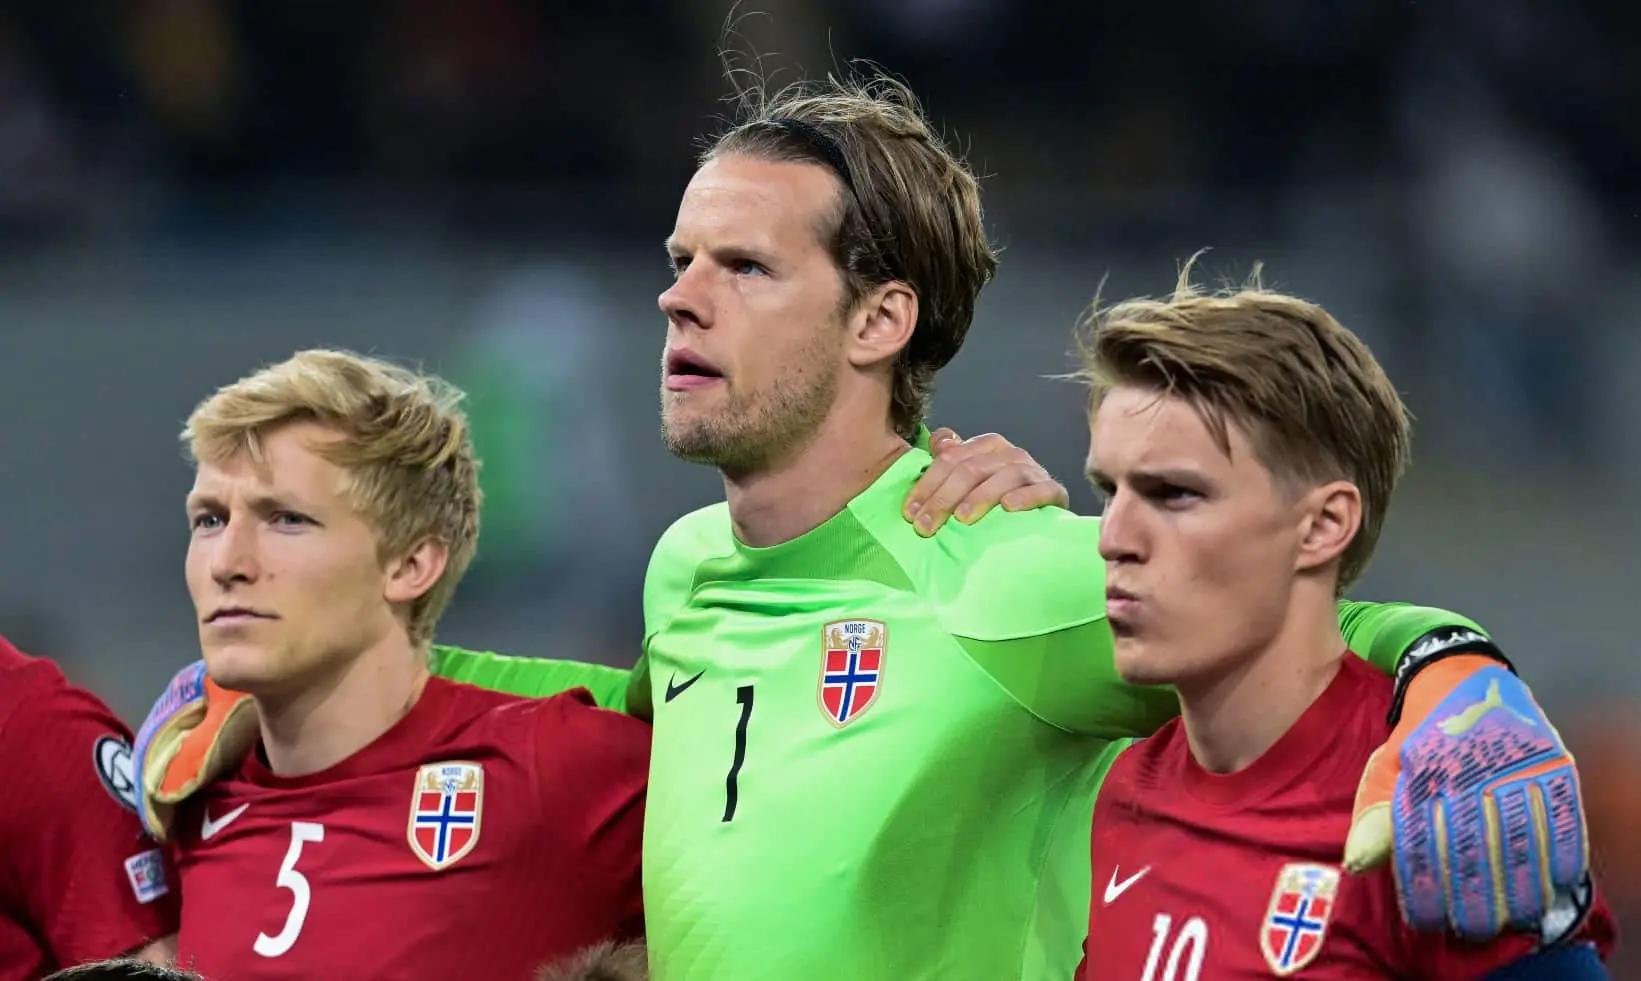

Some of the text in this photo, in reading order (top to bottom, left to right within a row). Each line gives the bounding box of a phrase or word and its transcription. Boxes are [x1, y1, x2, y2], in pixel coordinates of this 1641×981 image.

[844, 623, 866, 634] NORGE
[721, 685, 754, 823] 1
[253, 821, 325, 958] 5
[1141, 912, 1209, 981] 10
